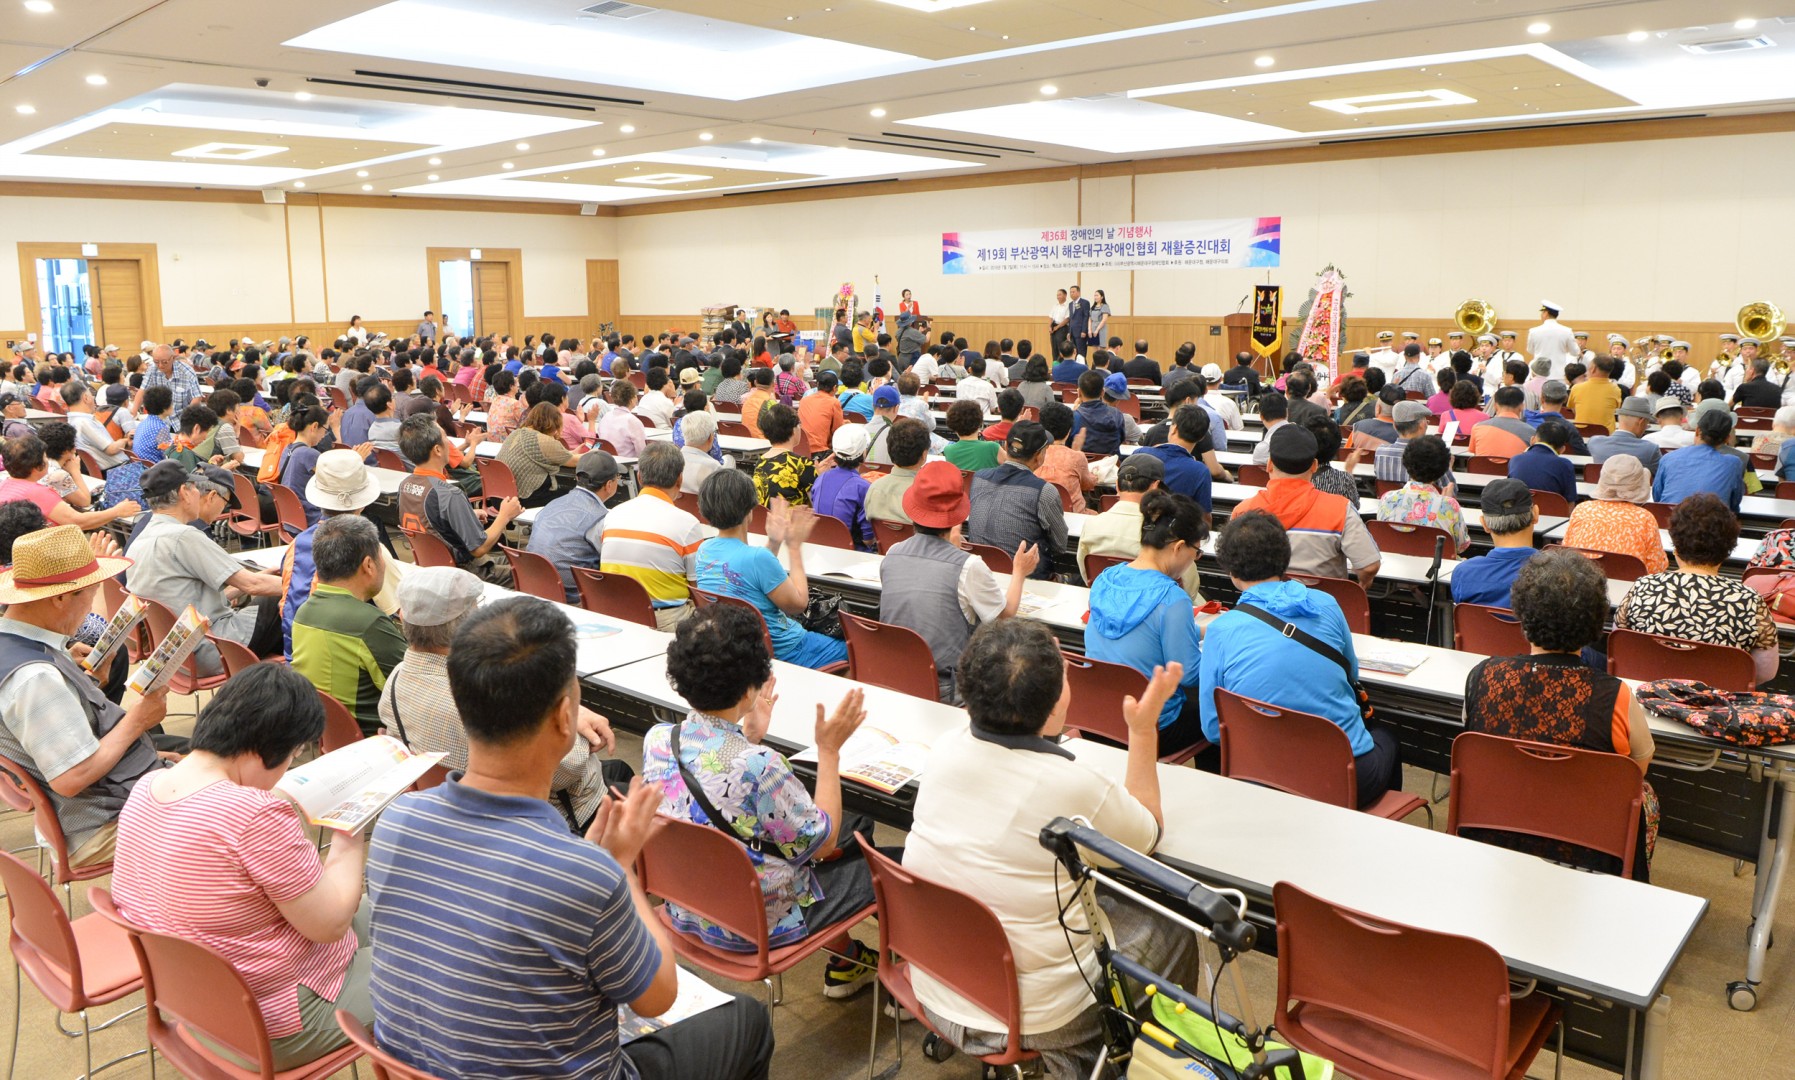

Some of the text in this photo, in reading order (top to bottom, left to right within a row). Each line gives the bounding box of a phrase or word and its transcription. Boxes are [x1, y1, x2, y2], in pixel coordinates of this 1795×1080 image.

[1041, 226, 1152, 242] 제36회 장애인의 날 기념행사
[977, 239, 1231, 261] 제19회 부산광역시 해운대구장애인협회 재활증진대회
